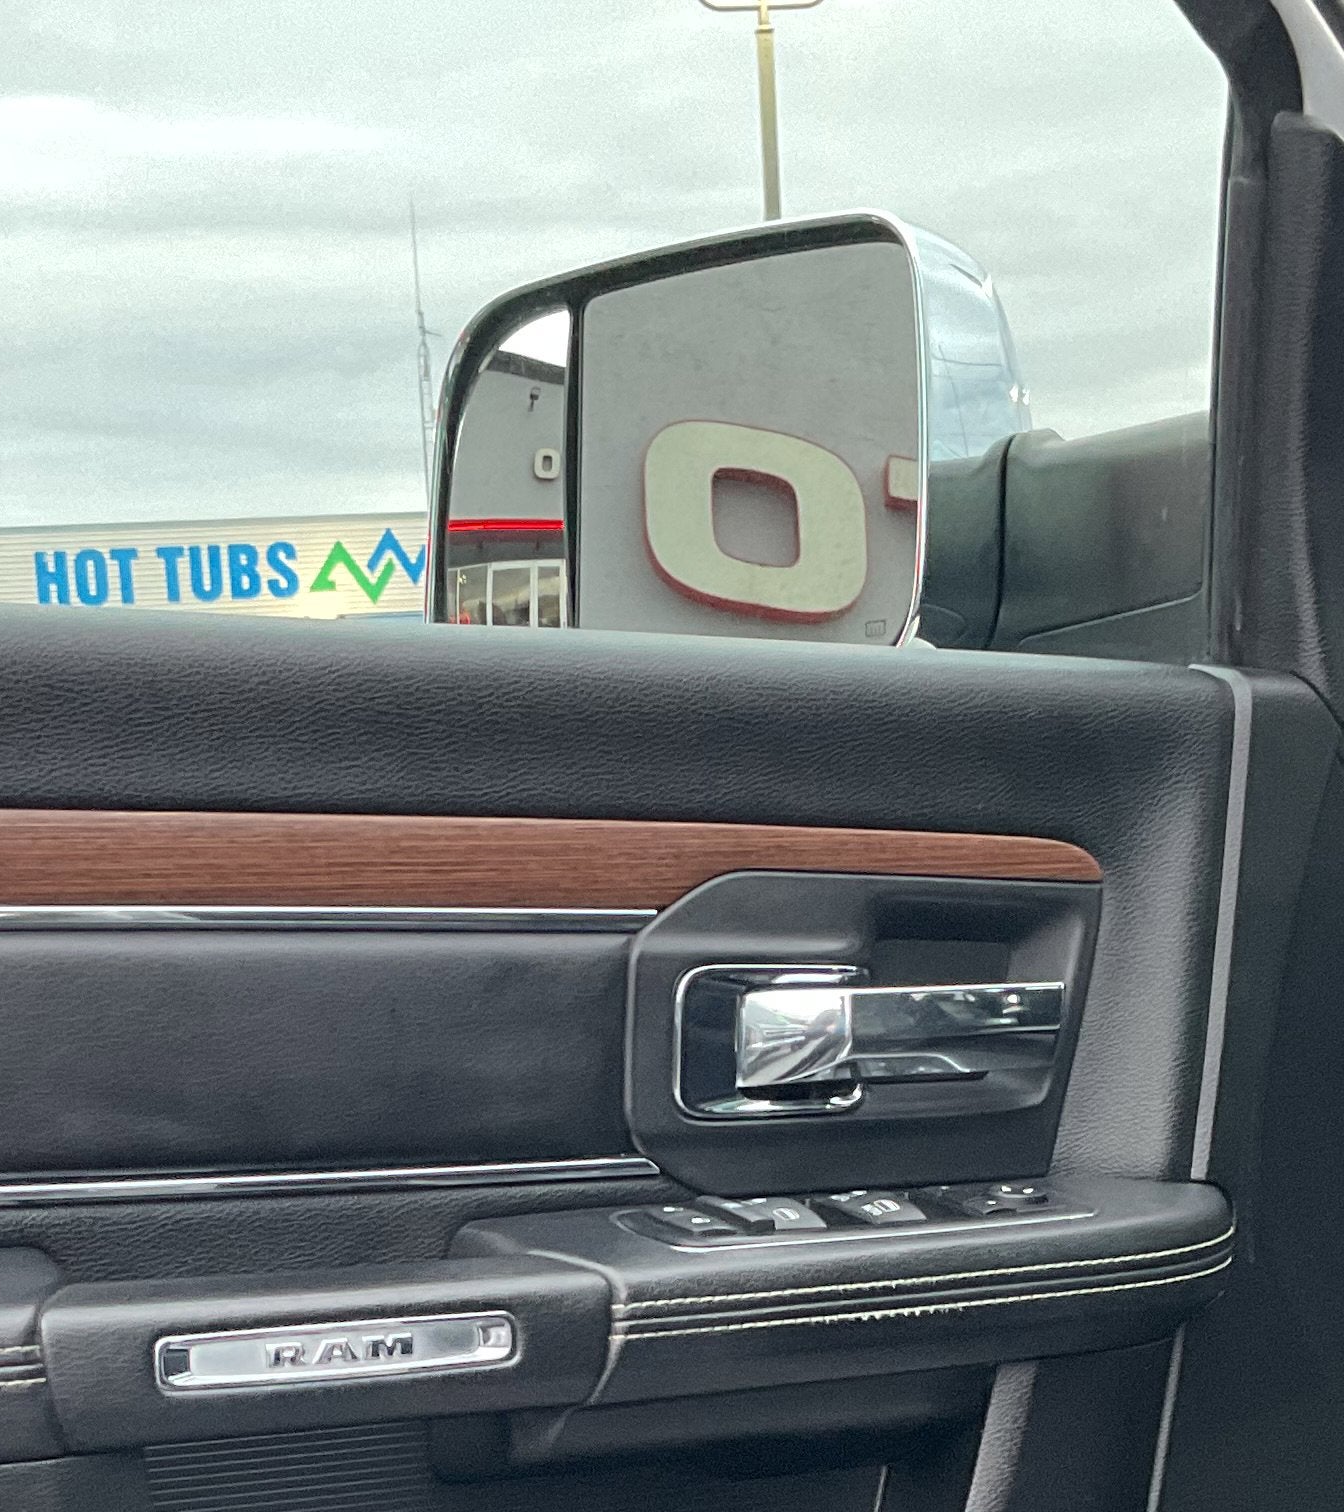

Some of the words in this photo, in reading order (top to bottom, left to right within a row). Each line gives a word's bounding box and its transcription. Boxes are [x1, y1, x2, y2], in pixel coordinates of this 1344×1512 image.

[33, 547, 139, 607] HOT
[155, 541, 301, 602] TUBS
[265, 1332, 415, 1369] RAM
